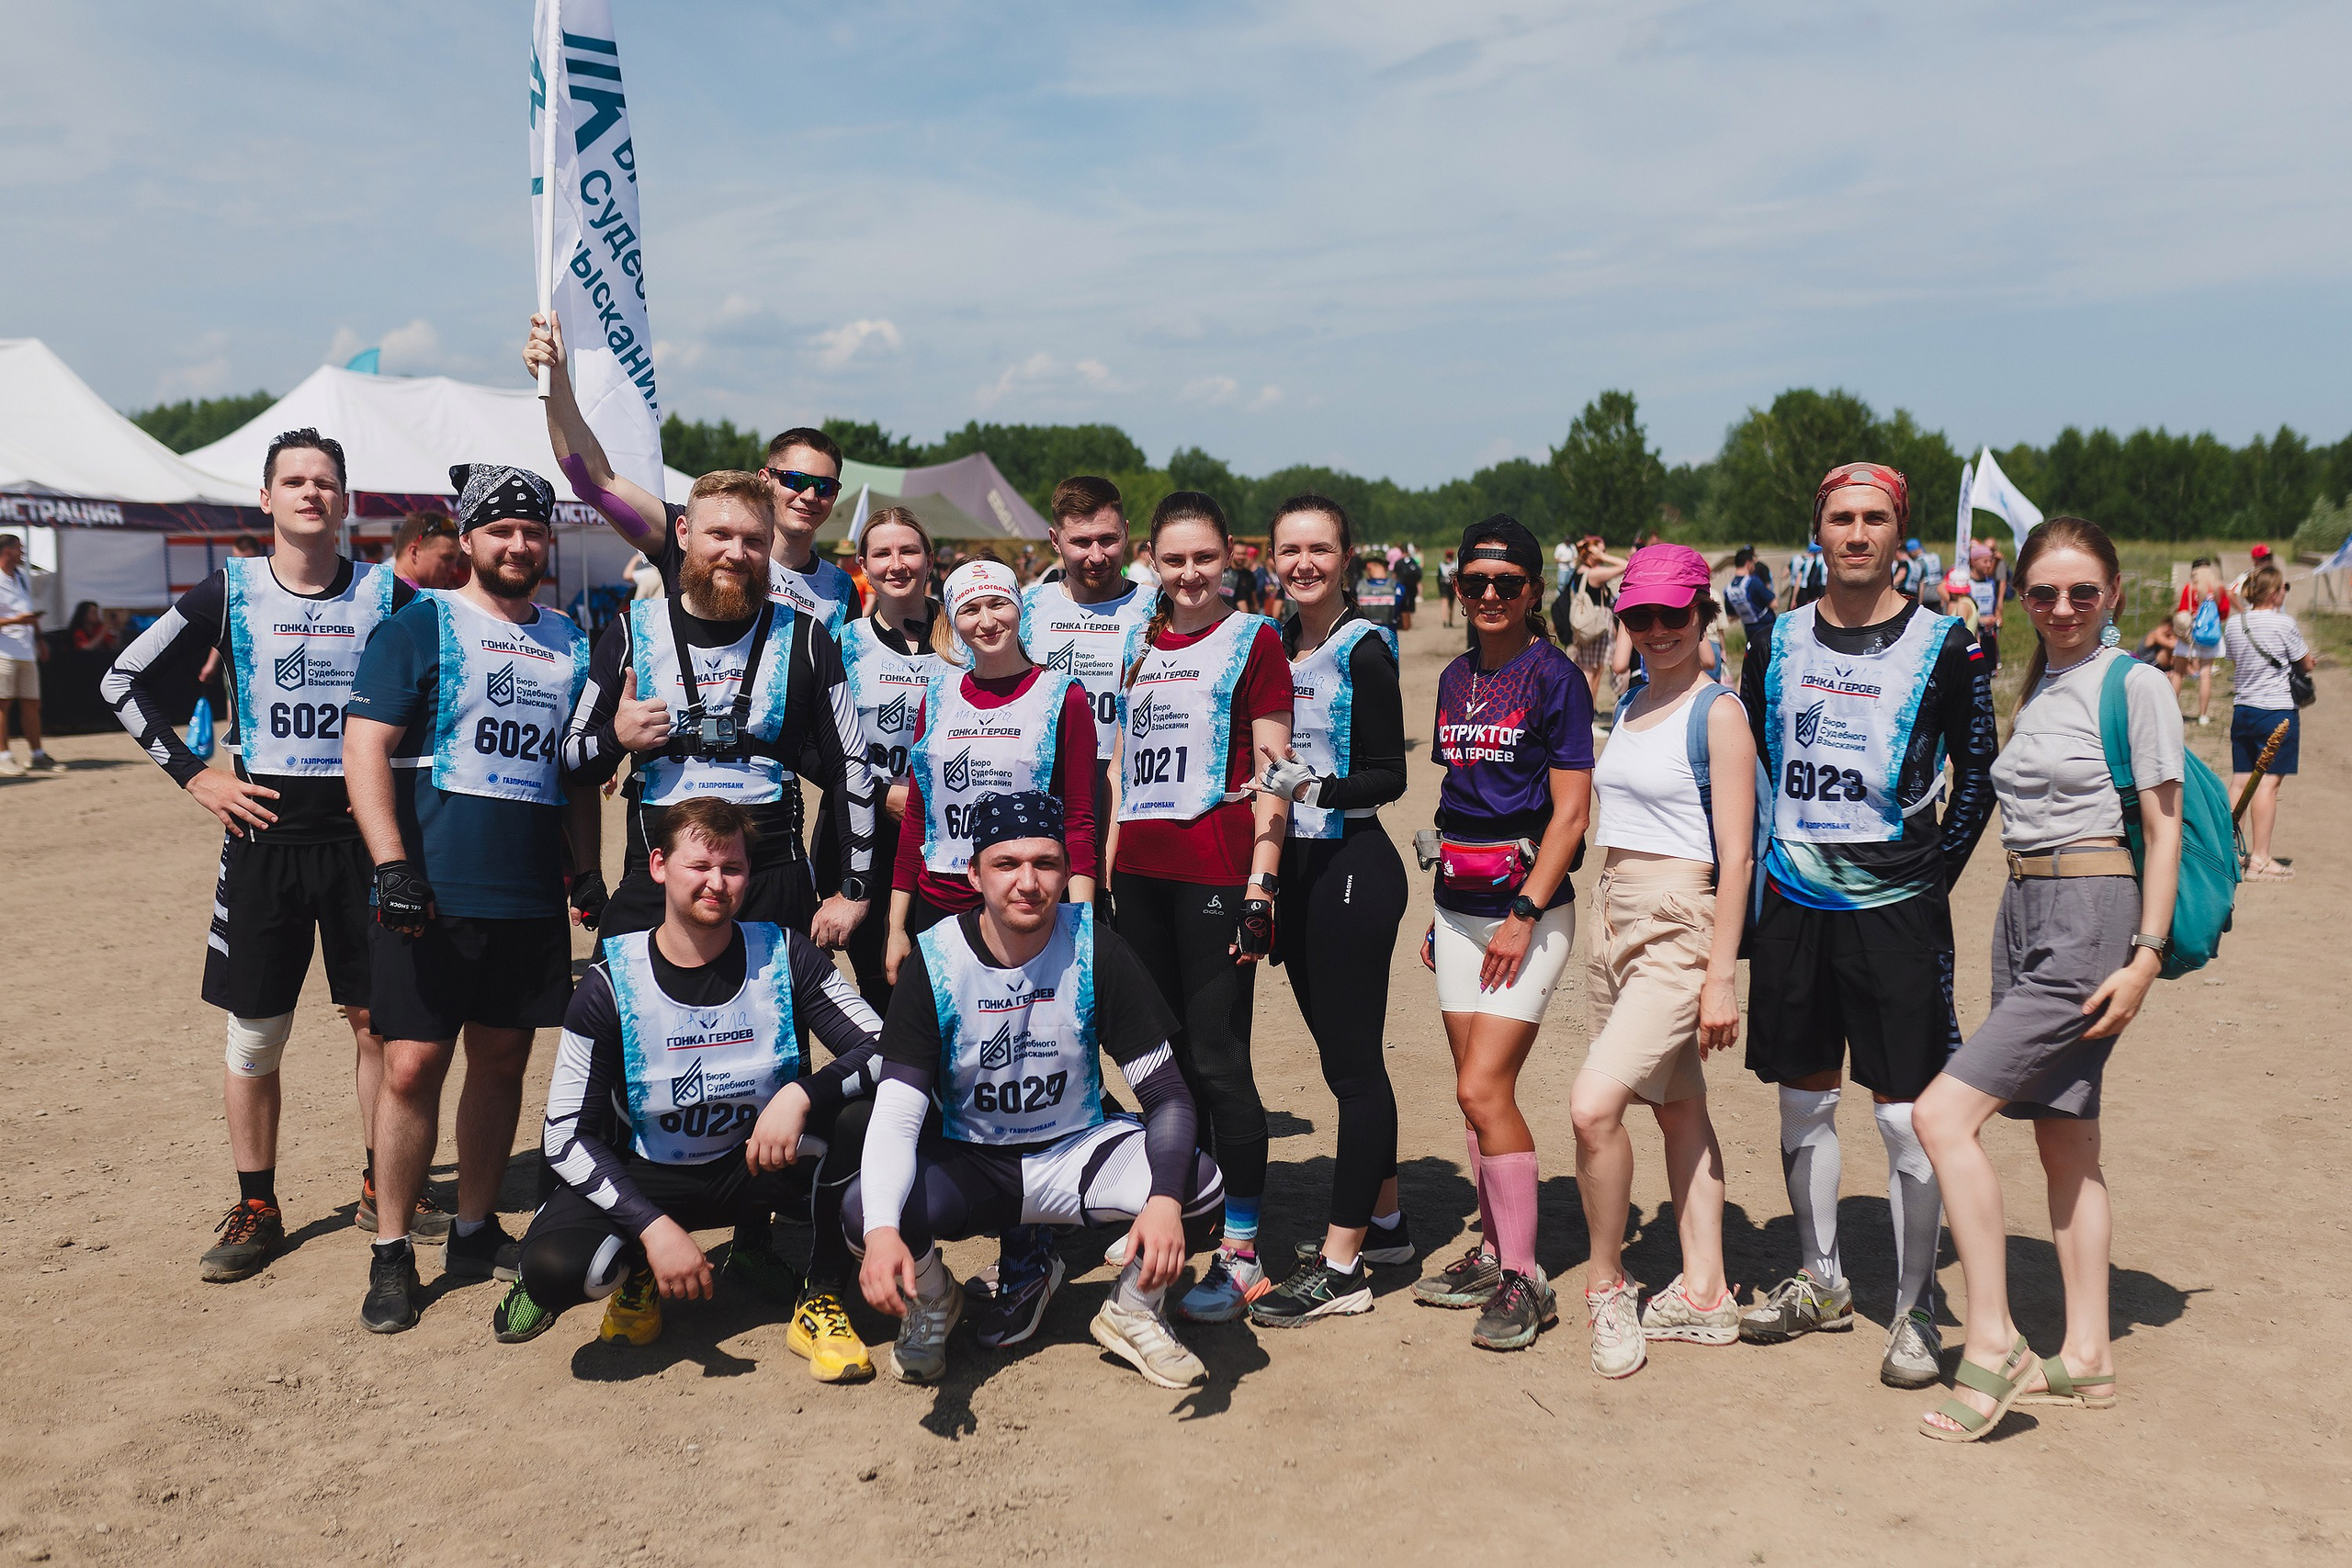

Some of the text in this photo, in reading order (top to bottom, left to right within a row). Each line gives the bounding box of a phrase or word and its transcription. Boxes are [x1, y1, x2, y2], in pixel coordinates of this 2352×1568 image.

[784, 587, 816, 609] ГЕРОЕВ
[274, 624, 355, 635] ГОНКА ГЕРОЕВ
[1050, 622, 1120, 631] ГОНКА ГЕРОЕВ
[481, 639, 555, 660] ГОНКА ГЕРОЕВ
[308, 659, 332, 669] Бюро
[1074, 660, 1114, 669] Судебного
[308, 669, 356, 678] Судебного
[879, 673, 912, 683] ГОНКА
[1073, 669, 1114, 677] Взыскания
[1136, 670, 1200, 684] ГОНКА ГЕРОЕВ
[516, 677, 537, 687] Бюро
[1801, 675, 1882, 695] ГОНКА ГЕРОЕВ
[516, 687, 558, 701] Судебного
[1294, 686, 1315, 696] РОЕВ
[516, 696, 557, 711] Взыскания
[1153, 704, 1171, 713] Бюро
[1152, 712, 1189, 720] Судебного
[1151, 722, 1189, 730] Взыскания
[1822, 716, 1847, 729] Бюро
[947, 728, 1022, 737] ГОНКА ГЕРОЕВ
[1440, 724, 1525, 746] СТРУКТОР
[1820, 726, 1867, 741] Судебного
[474, 716, 556, 765] 6024
[1816, 736, 1866, 752] Взыскания
[1465, 747, 1515, 763] ГЕРОЕВ
[970, 759, 991, 768] Бюро
[970, 769, 1012, 778] Судебного
[503, 776, 542, 789] ГАЗПРОМБАНК
[698, 782, 744, 790] ГАЗПРОМБАНК
[972, 779, 1012, 787] Взыскания
[1785, 760, 1867, 802] 6023
[978, 987, 1056, 1010] ГОНКА ГЕРОЕВ
[666, 1028, 753, 1047] ГОНКА ГЕРОЕВ
[706, 1071, 731, 1081] Бюро
[707, 1078, 755, 1092] Судебного
[1009, 1120, 1057, 1134] ГАЗПРОМБАНК
